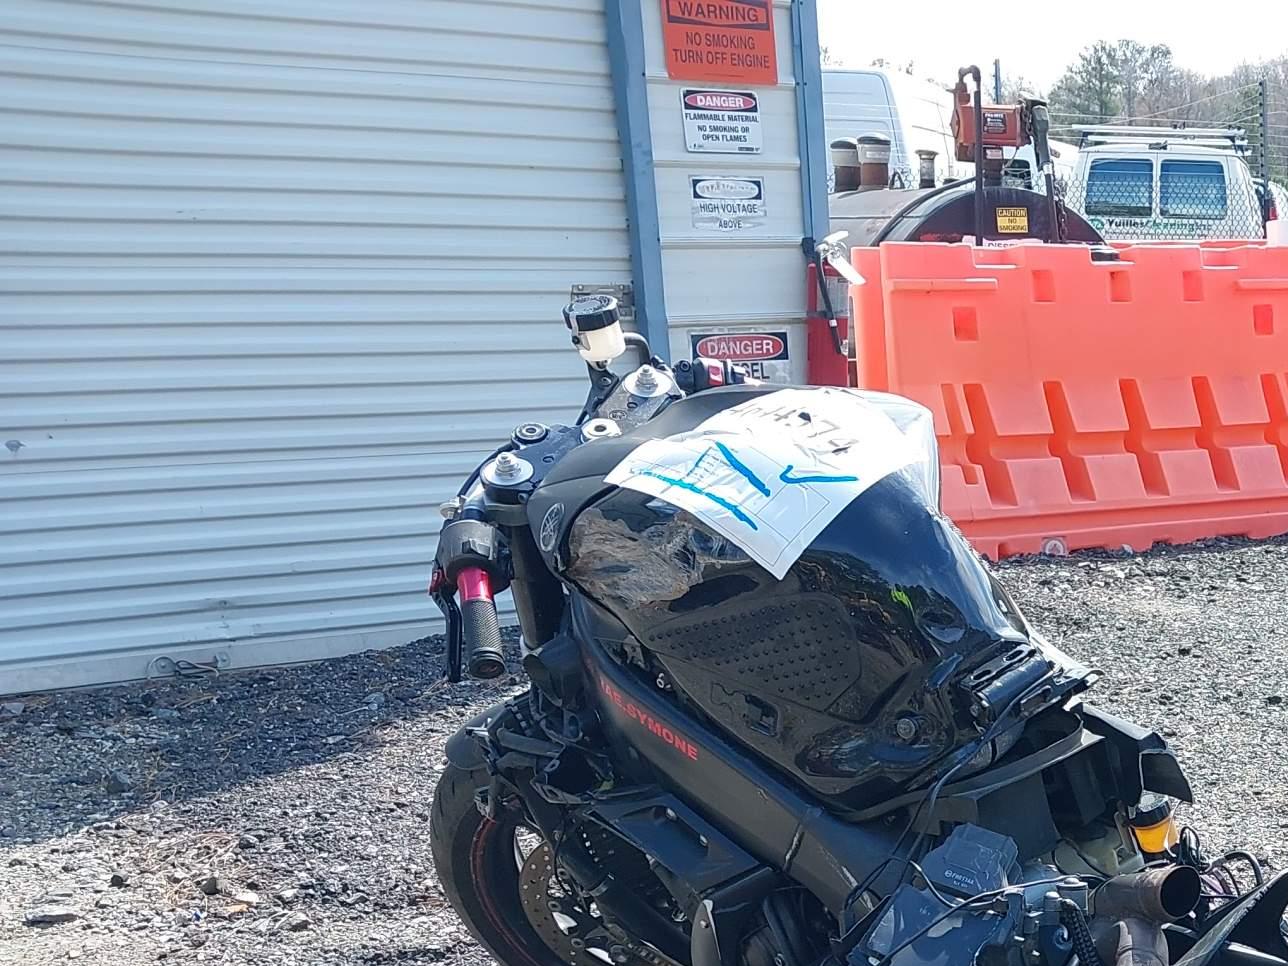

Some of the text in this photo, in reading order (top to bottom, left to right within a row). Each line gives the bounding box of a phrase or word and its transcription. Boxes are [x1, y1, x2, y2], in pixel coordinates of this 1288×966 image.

[679, 1, 759, 22] WARNING
[685, 31, 756, 50] NO SMOKING
[672, 49, 770, 69] TURN OFF ENGINE
[696, 95, 744, 108] DANGER
[685, 112, 760, 123] FLAMMABLE MATERIAL
[697, 124, 707, 132] NO
[708, 125, 740, 133] SMOKING
[702, 134, 748, 143] OPEN FLAMES
[699, 203, 759, 214] HIGH VOLTAGE
[998, 209, 1026, 217] CAUTION
[718, 220, 743, 229] ABOVE
[706, 339, 774, 356] DANGER
